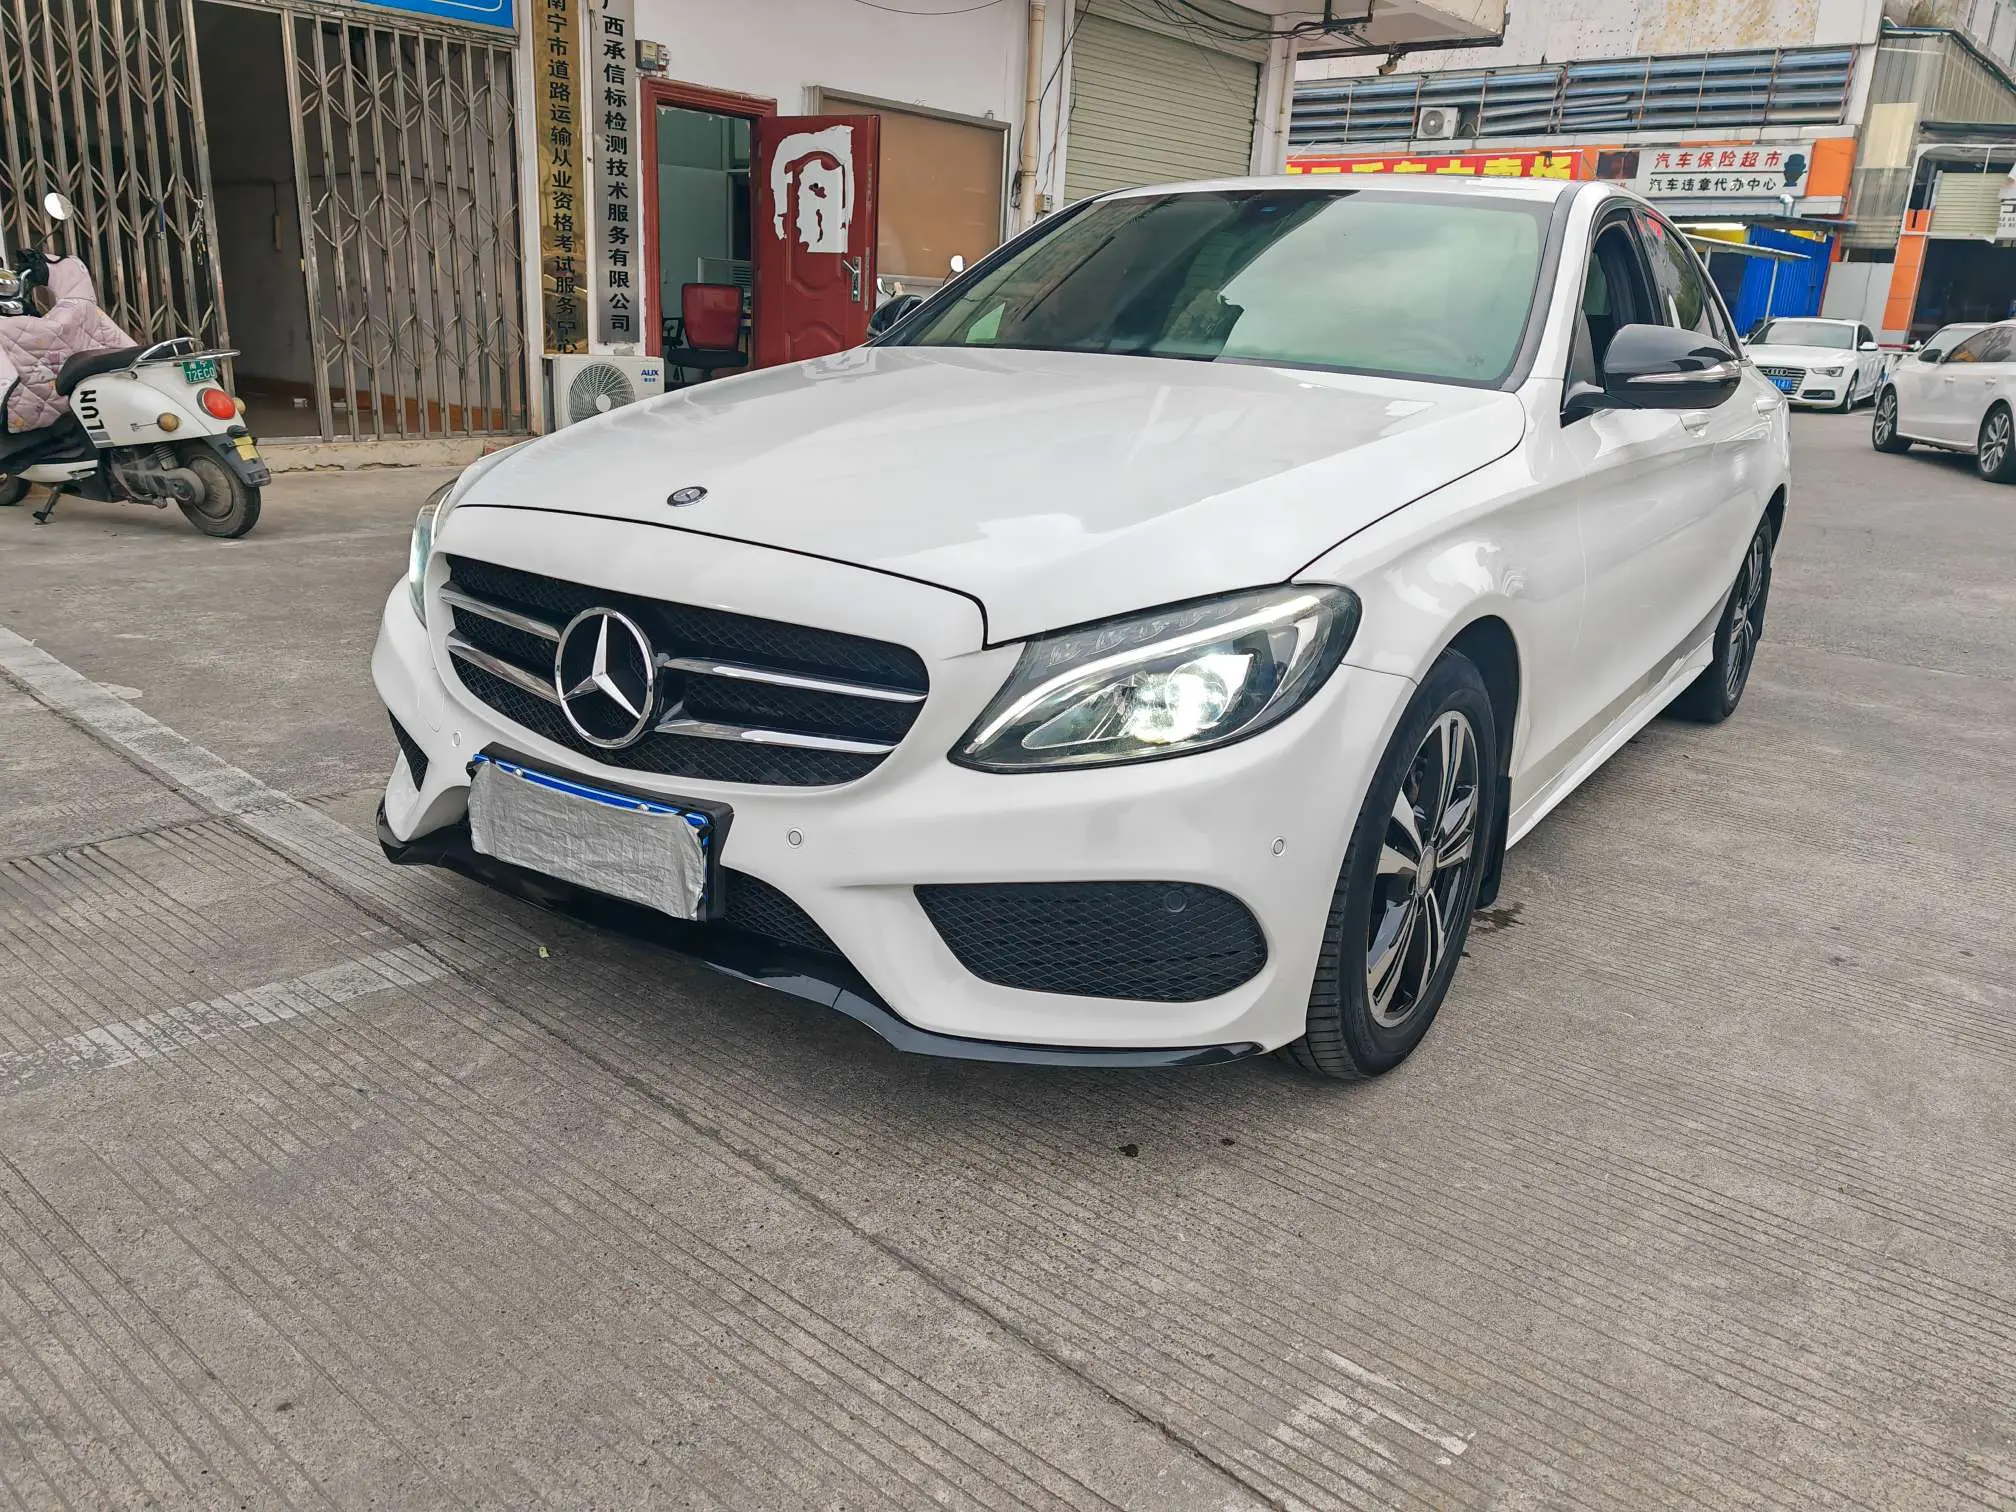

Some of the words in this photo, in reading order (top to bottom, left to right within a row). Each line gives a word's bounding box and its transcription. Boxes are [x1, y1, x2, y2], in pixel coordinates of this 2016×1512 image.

[602, 0, 630, 332] 西承信标检测技术服务有限公司
[1654, 151, 1783, 169] 汽车保险超市
[1648, 177, 1777, 192] 汽车违章代办中心
[641, 369, 660, 377] AUX
[80, 390, 105, 430] LUN
